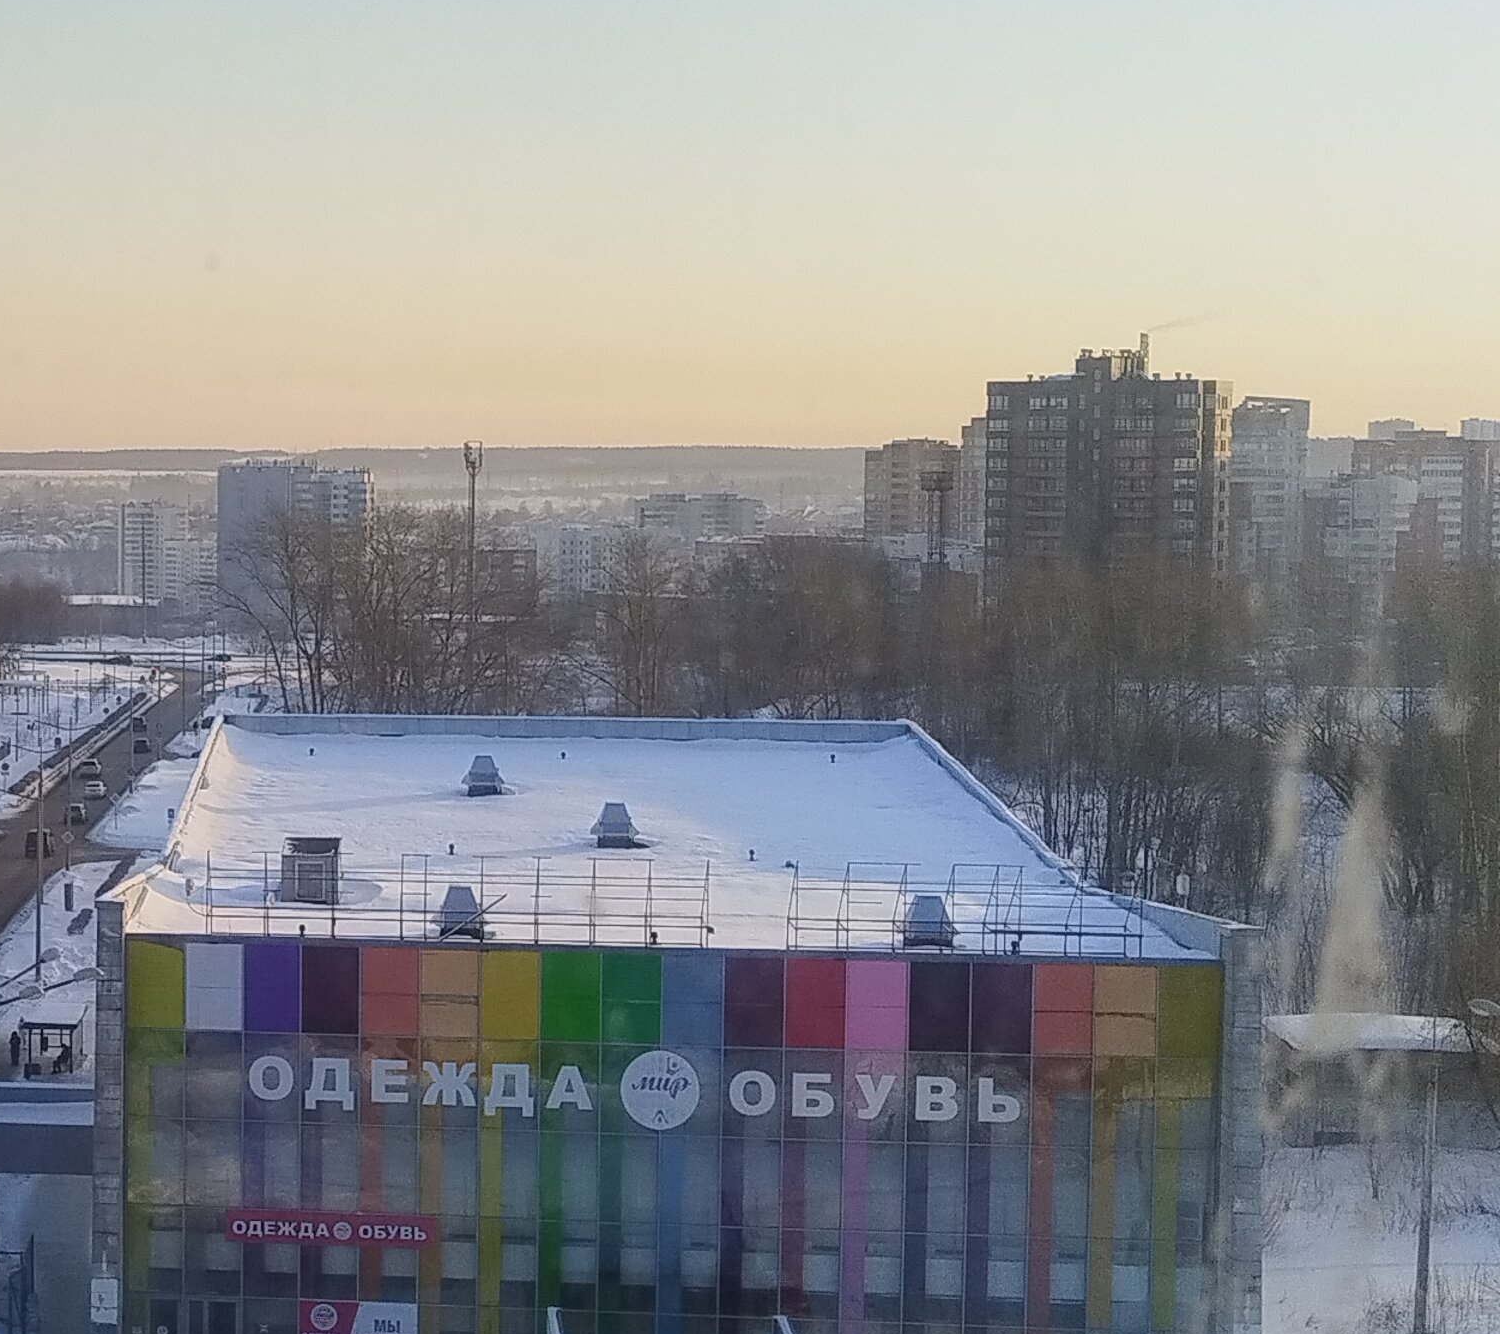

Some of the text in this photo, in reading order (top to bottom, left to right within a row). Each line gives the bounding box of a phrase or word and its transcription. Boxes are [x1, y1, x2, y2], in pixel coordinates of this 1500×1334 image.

[247, 1054, 594, 1117] ОДЕЖДА
[728, 1068, 1022, 1125] ОБУВЬ
[231, 1220, 330, 1240] ОДЕЖДА
[358, 1224, 428, 1241] ОБУВЬ
[373, 1318, 401, 1334] МЫ
